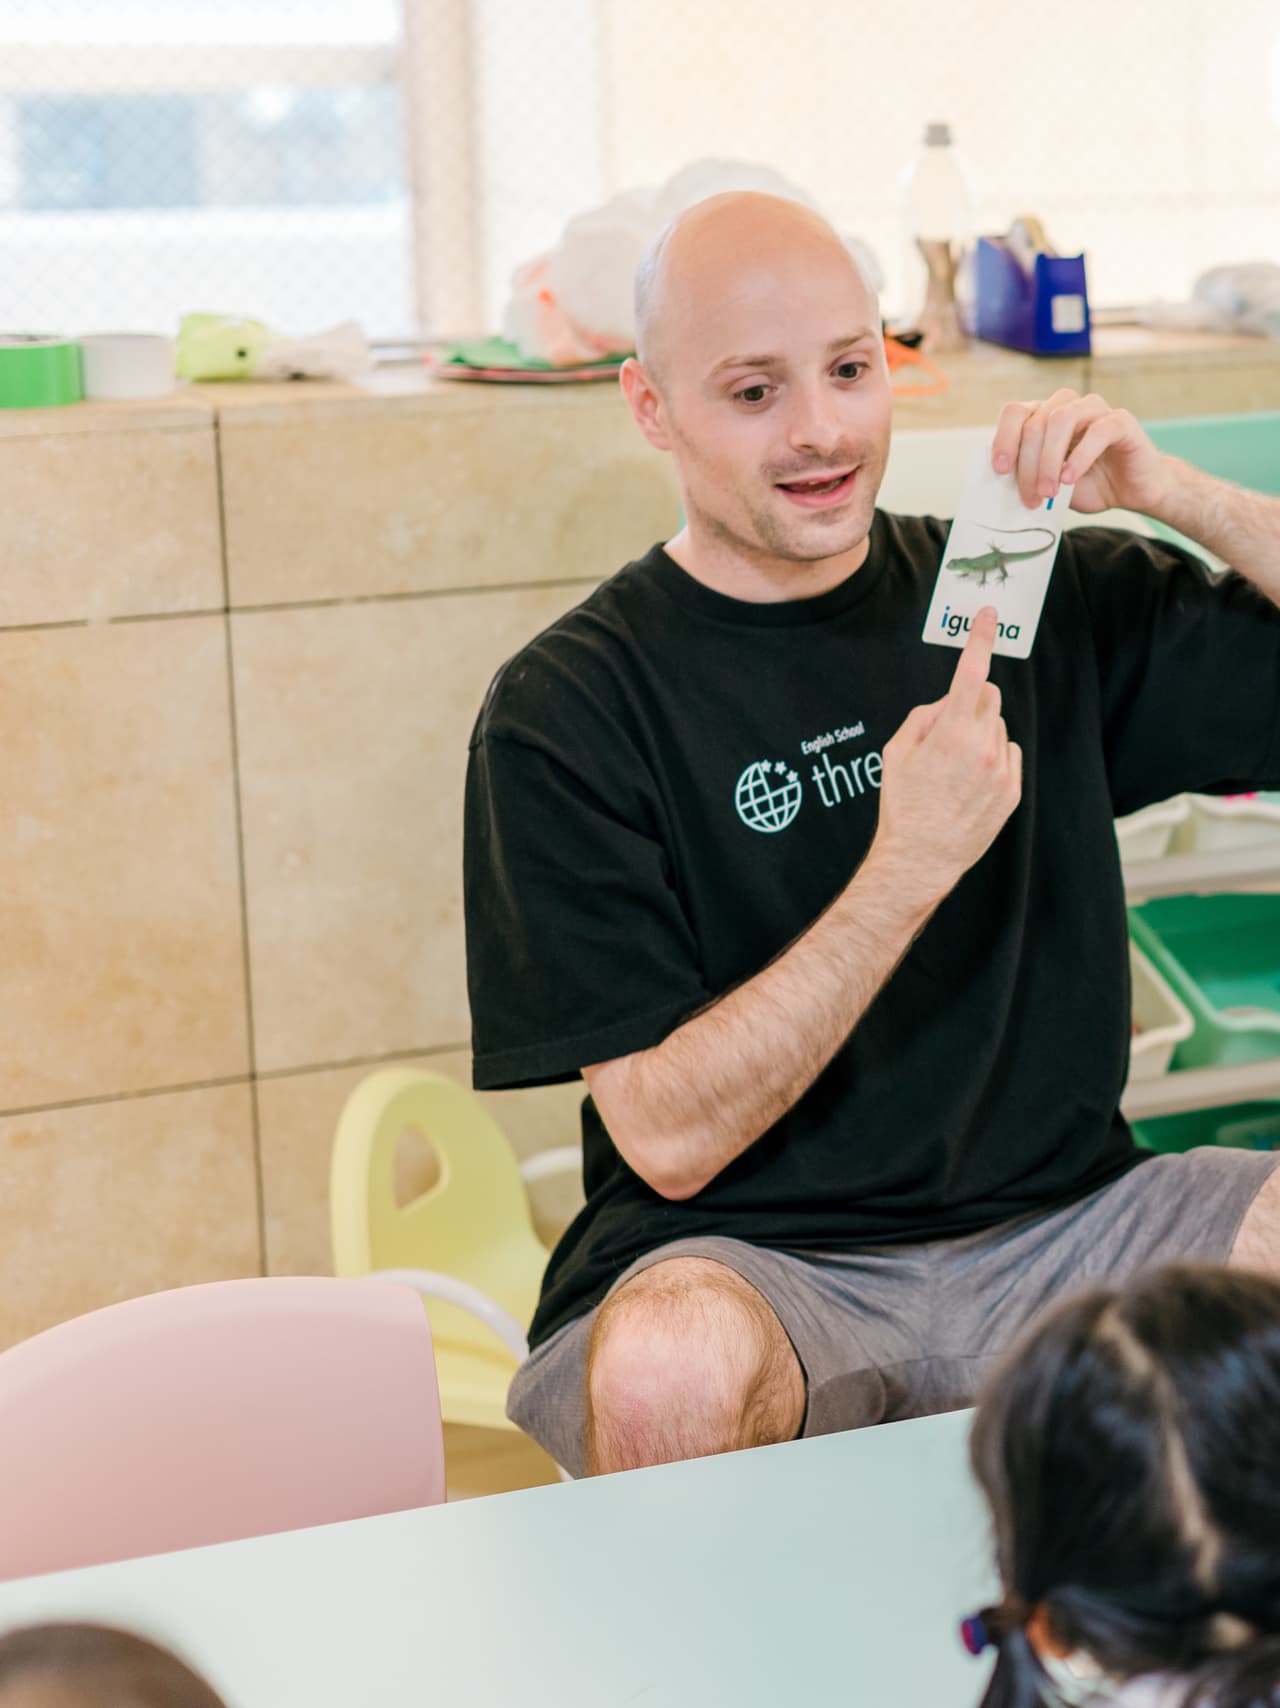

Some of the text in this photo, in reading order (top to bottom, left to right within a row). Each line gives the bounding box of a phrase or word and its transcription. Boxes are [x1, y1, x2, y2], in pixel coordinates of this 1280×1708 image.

[941, 605, 1021, 641] iguna
[801, 721, 865, 755] English School
[811, 751, 883, 807] thre
